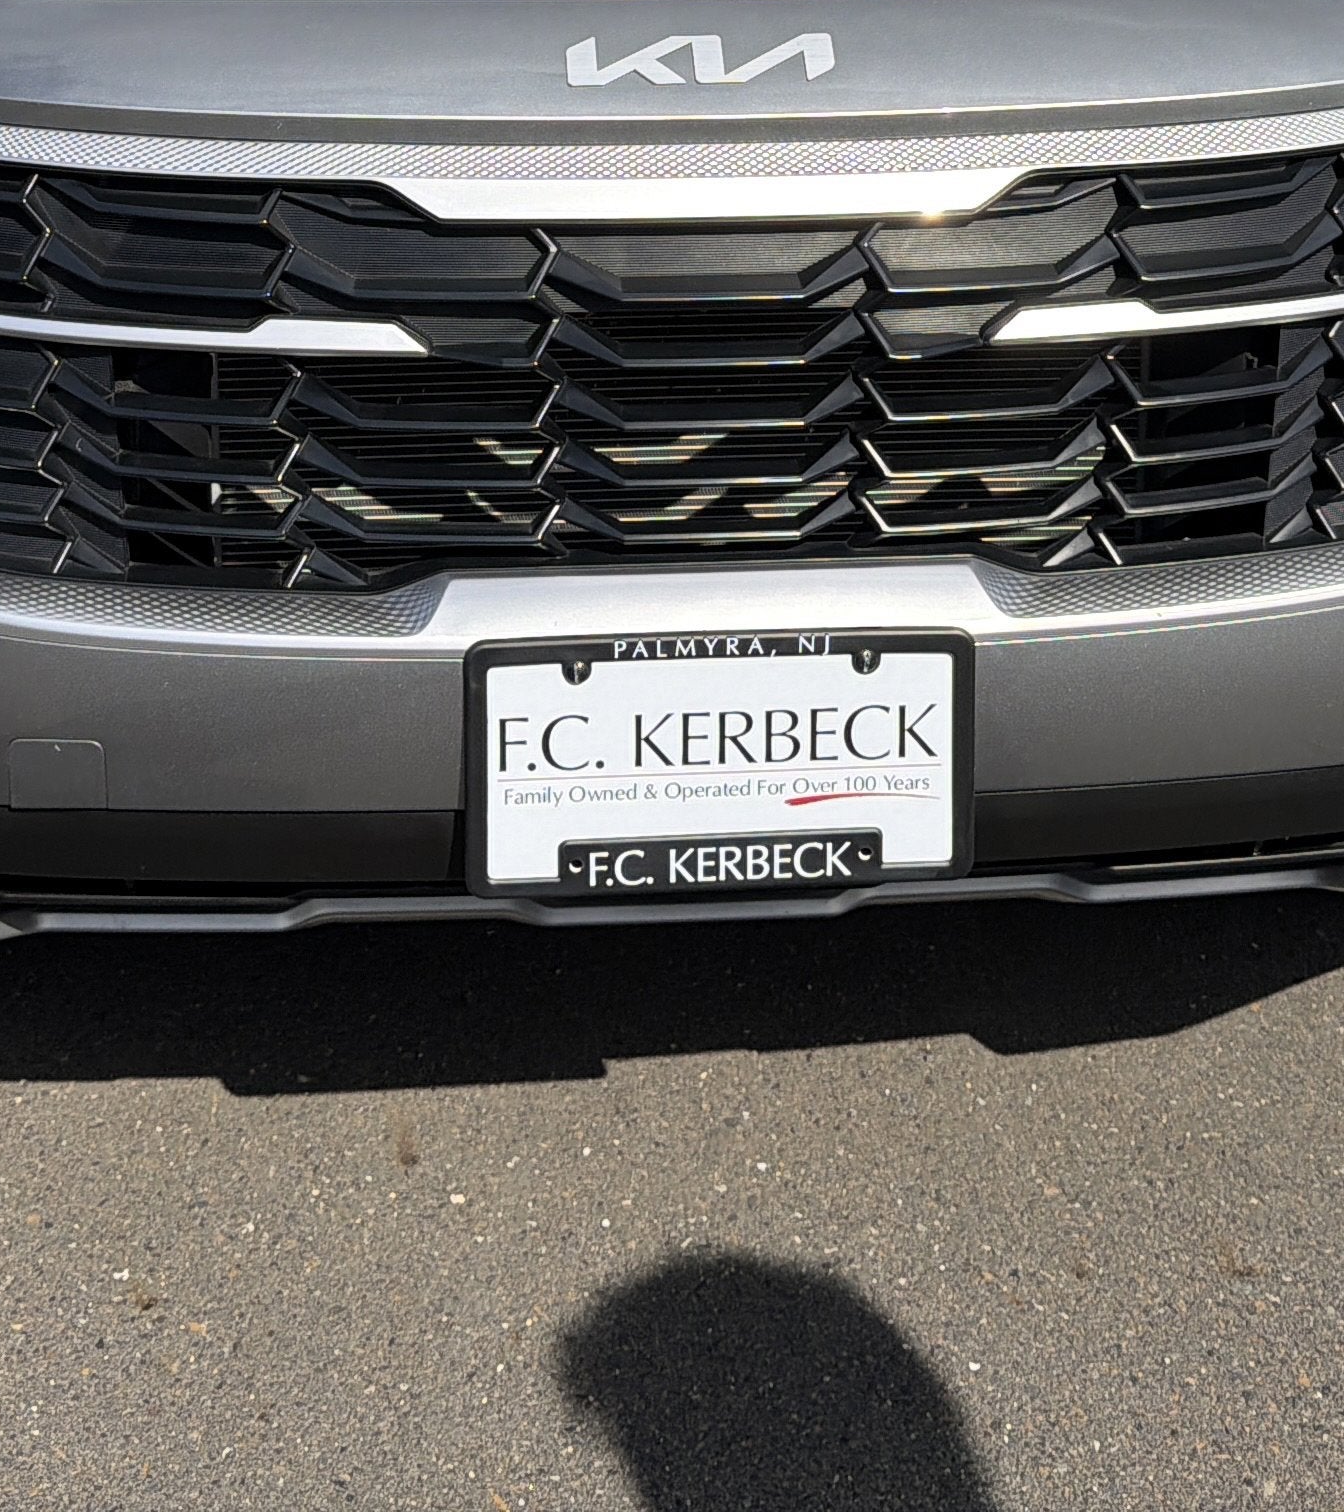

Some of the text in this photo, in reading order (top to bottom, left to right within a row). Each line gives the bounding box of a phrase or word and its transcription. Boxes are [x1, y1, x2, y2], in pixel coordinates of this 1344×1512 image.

[566, 33, 835, 88] KIA
[613, 634, 830, 658] PALMYRA, NJ
[499, 703, 938, 772] F.C. KERBECK
[504, 773, 930, 807] Family Owned & Operated For Over 100 Years
[589, 841, 852, 887] F.C. KERBECK
